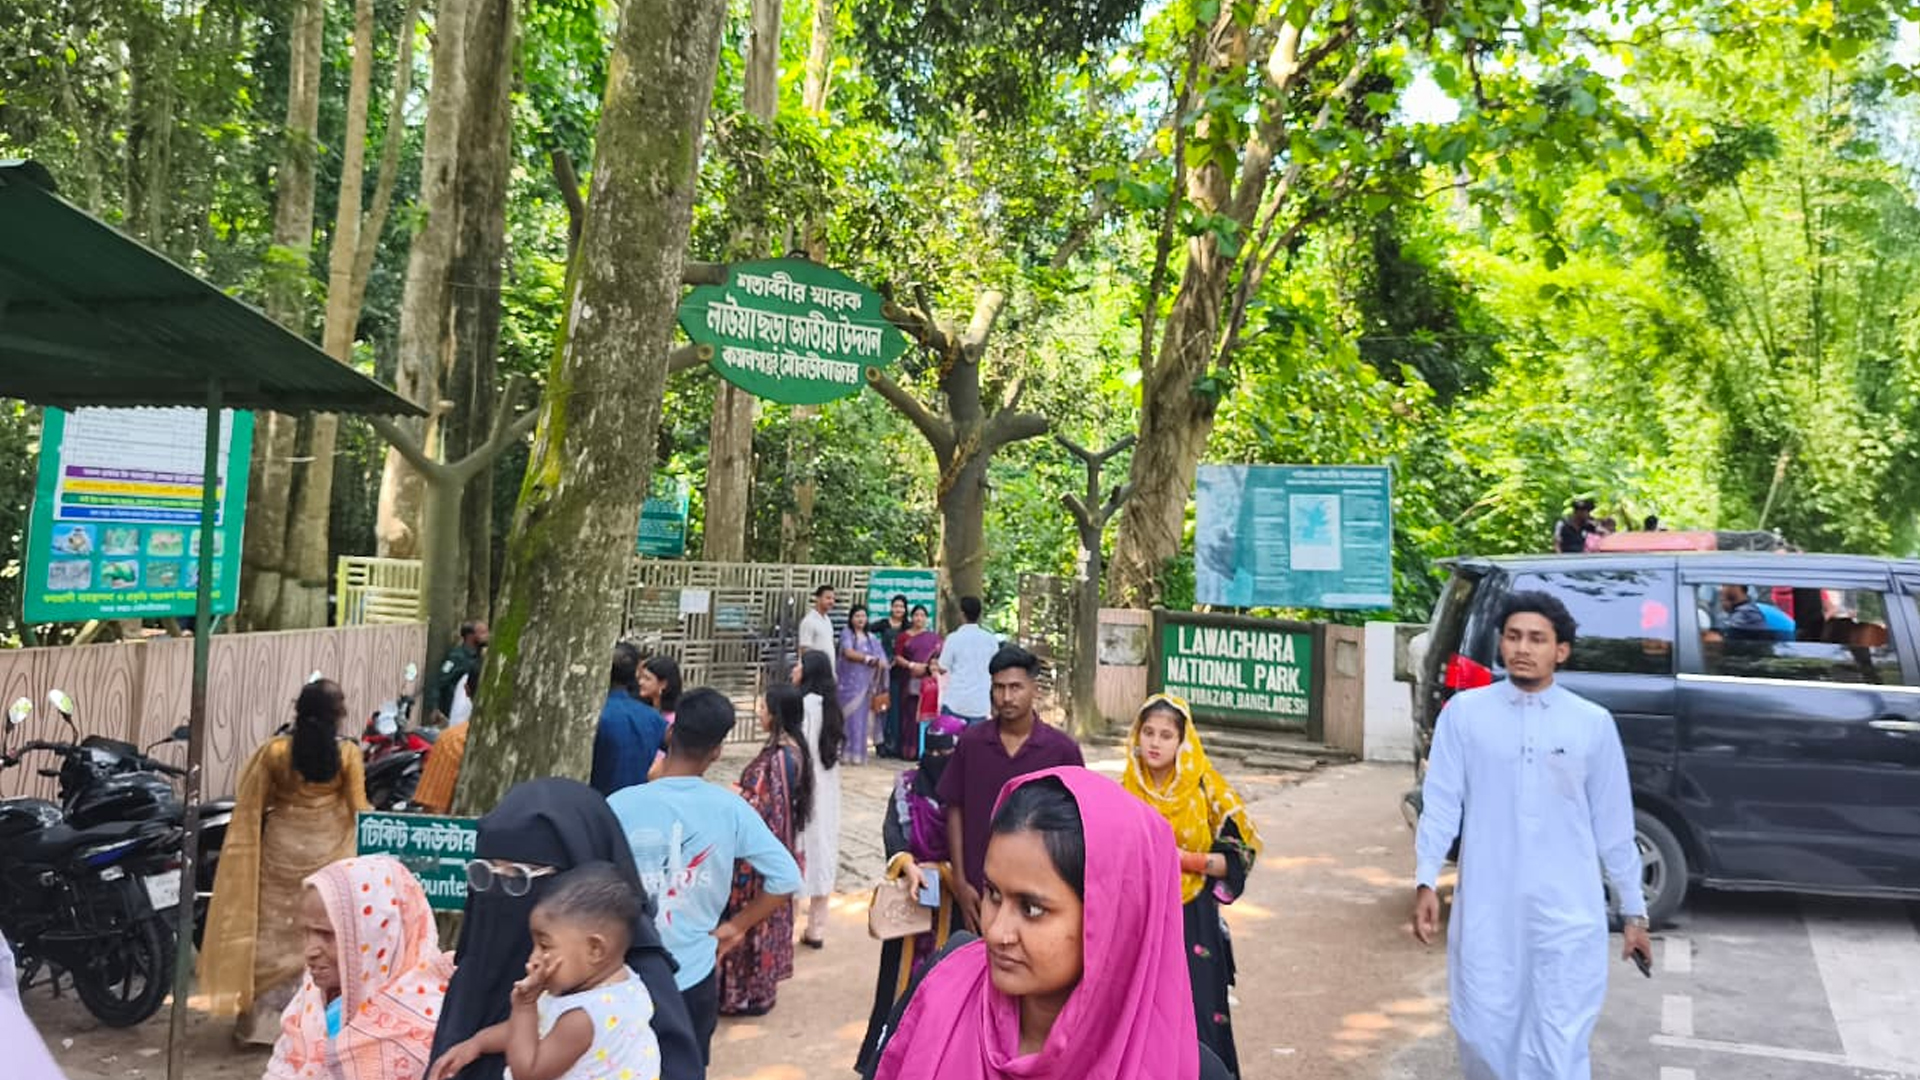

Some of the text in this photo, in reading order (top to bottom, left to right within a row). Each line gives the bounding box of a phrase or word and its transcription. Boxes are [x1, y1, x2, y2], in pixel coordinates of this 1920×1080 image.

[737, 271, 862, 311] শতাব্দীর স্মারক
[789, 311, 838, 354] জাতীয়
[840, 315, 882, 355] উদ্যান
[1178, 626, 1295, 663] LAWACHARA
[1167, 657, 1306, 694] NATIONAL PARK.
[361, 818, 477, 853] টিকিট কাউন্টার
